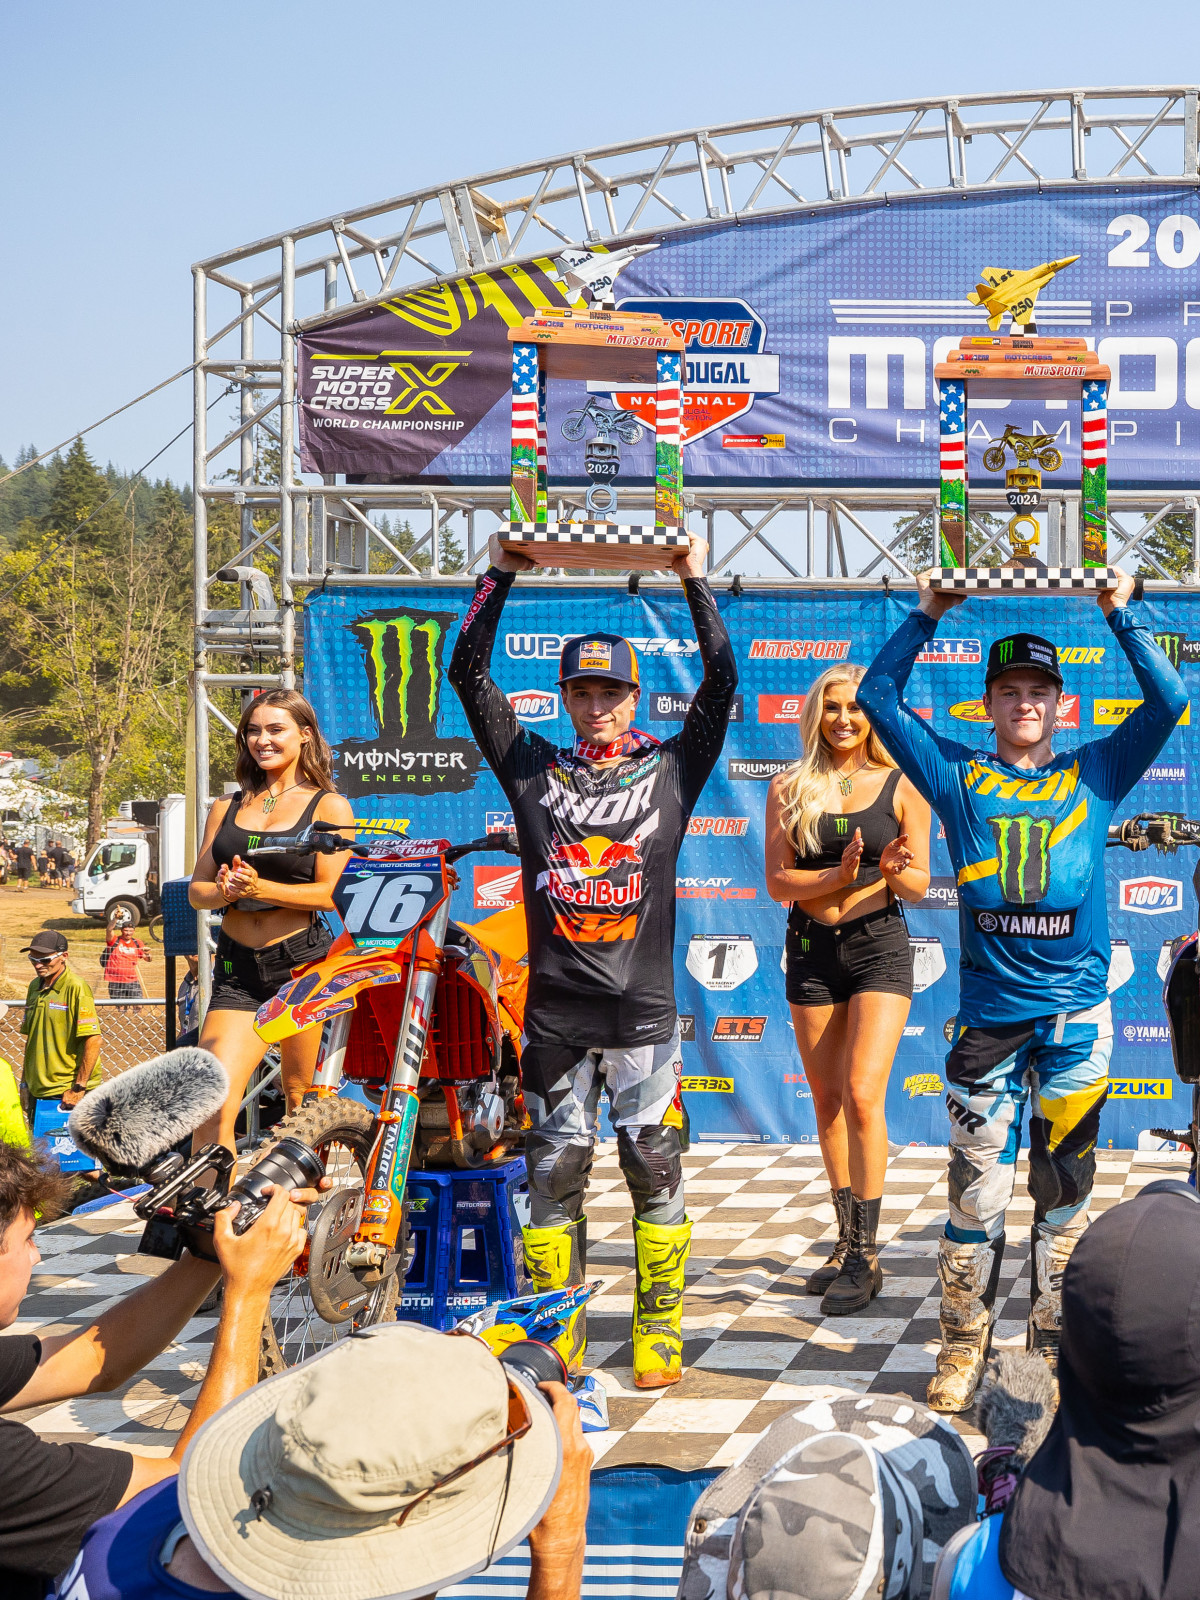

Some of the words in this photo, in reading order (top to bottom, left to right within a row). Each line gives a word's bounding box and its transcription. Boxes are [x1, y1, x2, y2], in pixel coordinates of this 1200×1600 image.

[570, 253, 594, 267] 2nd
[590, 275, 612, 293] 250
[990, 270, 1014, 288] 1st
[1011, 298, 1034, 317] 250
[670, 321, 753, 347] SPORT
[310, 366, 395, 380] SUPER
[687, 362, 750, 384] OUGAL
[316, 381, 391, 395] MOTO
[310, 396, 393, 411] CROSS
[631, 397, 736, 406] NAONAL
[313, 418, 359, 429] WORLD
[362, 419, 465, 431] CHAMPIONSHIP
[588, 463, 617, 475] 2024
[1010, 495, 1038, 505] 2024
[461, 600, 482, 633] Red
[475, 575, 497, 604] Bull
[506, 634, 586, 660] WP
[922, 639, 981, 653] RTS
[916, 654, 981, 663] LIMITED
[1057, 648, 1105, 663] HOR
[510, 695, 551, 716] 100%
[344, 748, 467, 769] MONSTER
[731, 763, 786, 774] TRIUMPH
[1150, 768, 1185, 777] YAMAHA
[362, 774, 446, 782] ENERGY
[354, 819, 410, 834] THOR
[548, 869, 592, 905] Red
[595, 872, 642, 906] Bull
[676, 887, 756, 900] EGENDS
[1129, 887, 1173, 904] 100%
[343, 875, 433, 933] 16
[553, 914, 637, 942] KTM
[999, 914, 1070, 936] YAMAHA
[717, 1018, 764, 1033] ETS
[1137, 1026, 1171, 1038] YAMAH
[681, 1079, 731, 1090] CERBIS
[904, 1074, 940, 1088] MOTO
[909, 1082, 944, 1098] TEES
[380, 1098, 401, 1174] DUNLP
[401, 1297, 487, 1306] OTOCROSS
[534, 1299, 576, 1323] AIROH
